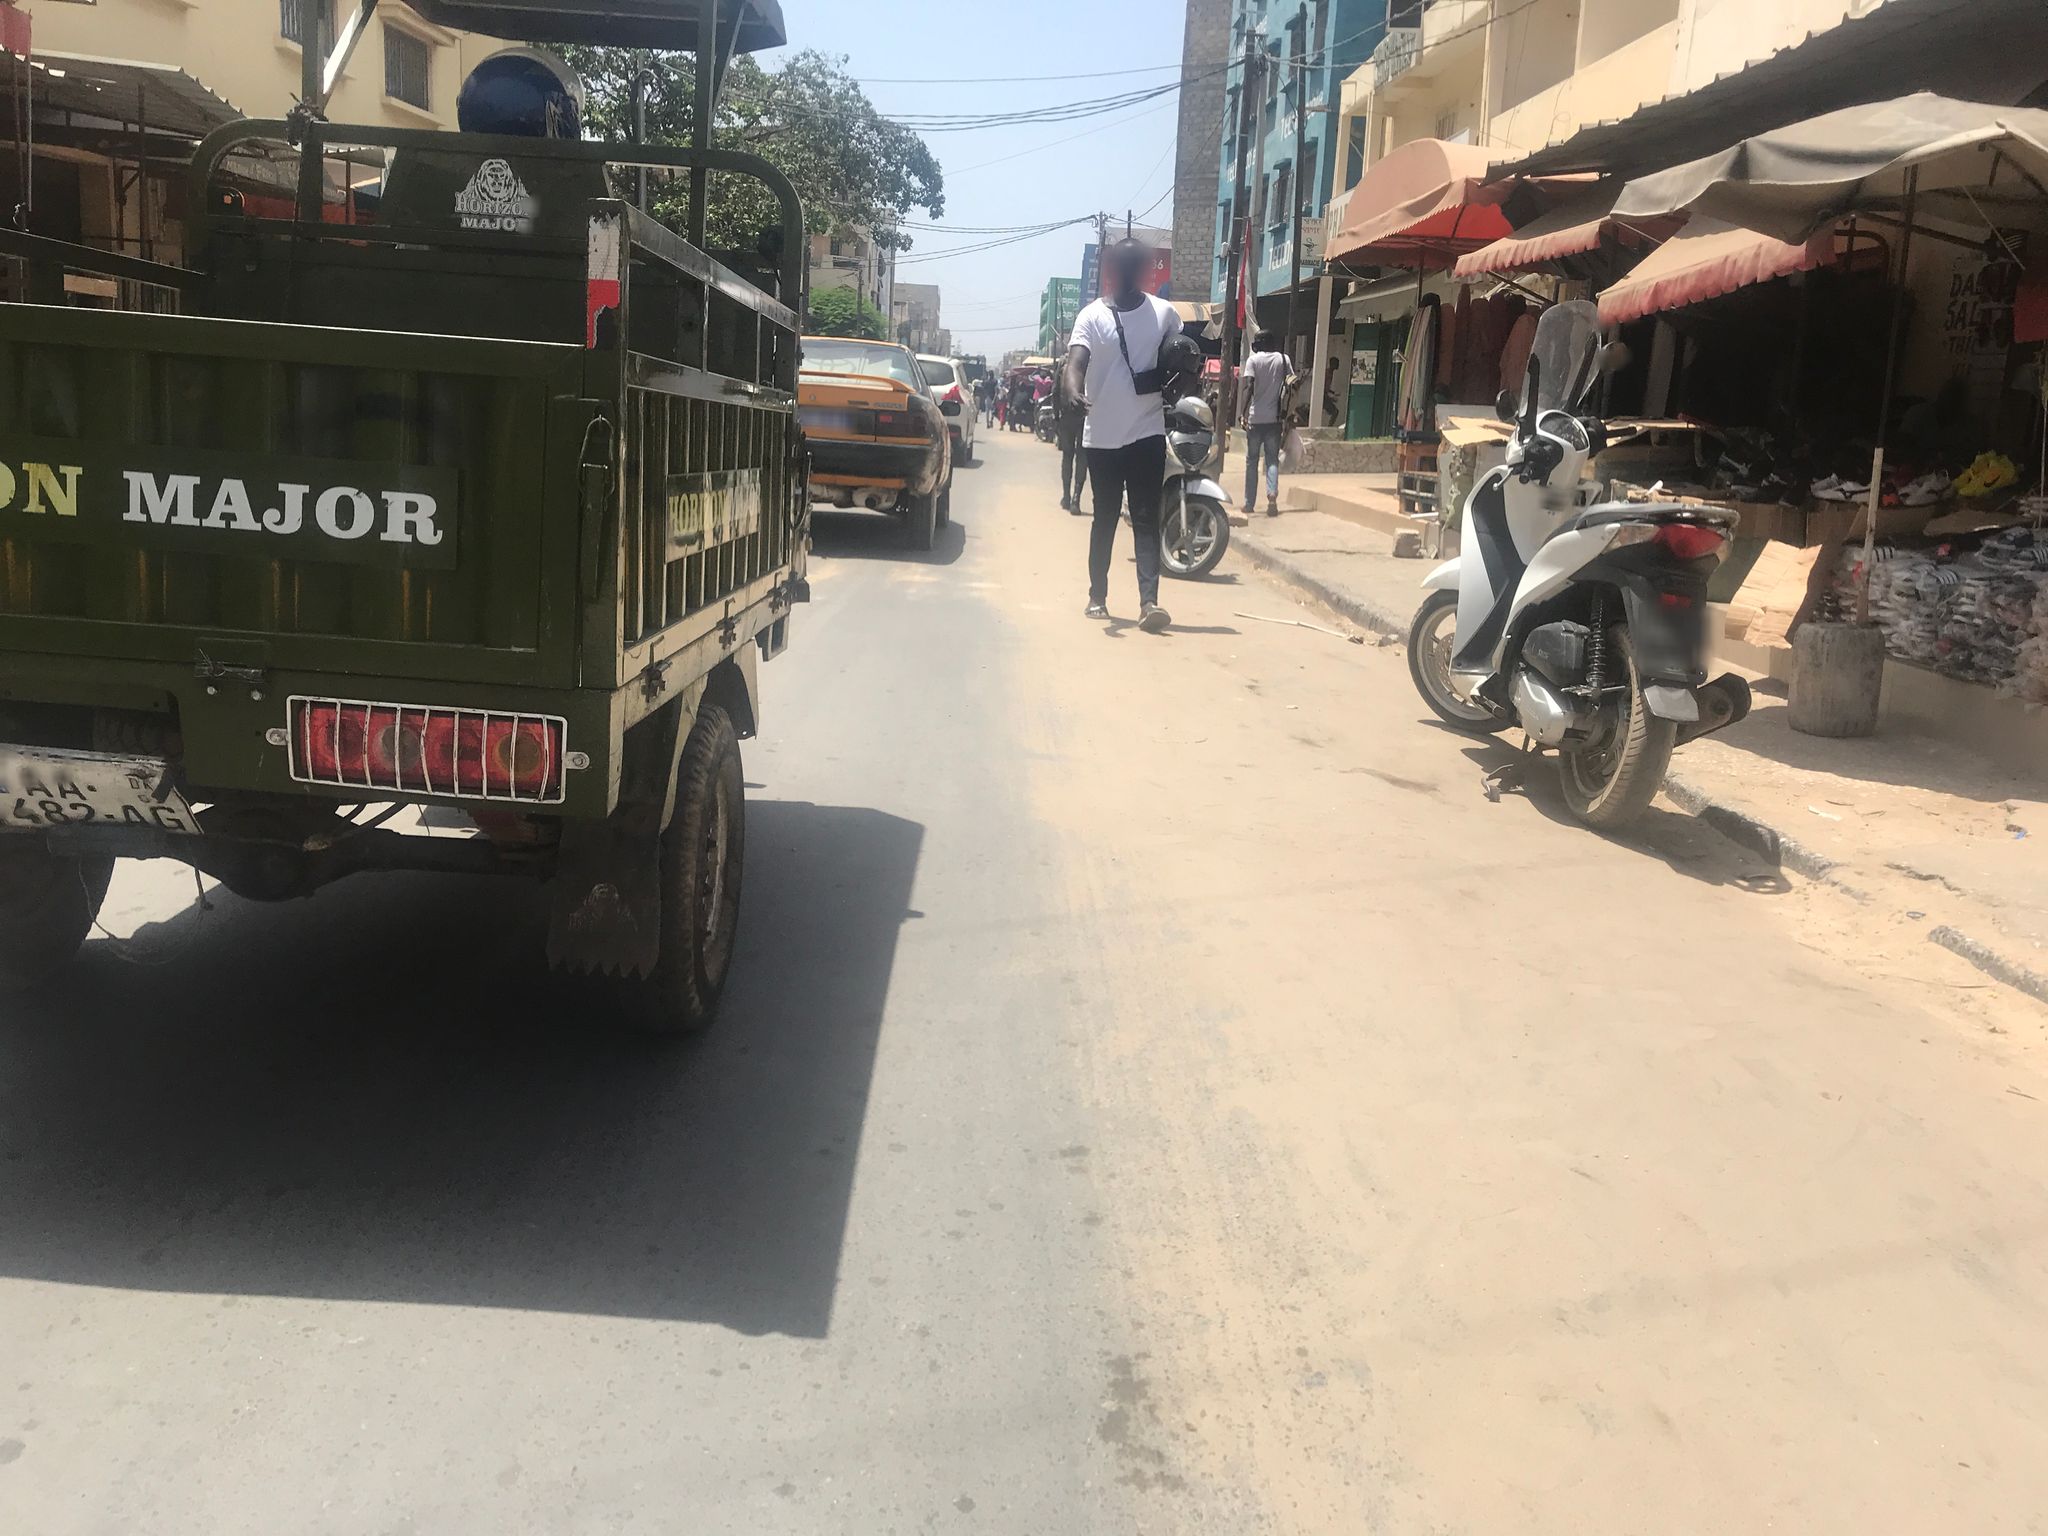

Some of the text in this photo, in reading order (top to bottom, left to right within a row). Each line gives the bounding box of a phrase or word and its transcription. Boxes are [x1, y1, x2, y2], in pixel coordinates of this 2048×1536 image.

[455, 191, 530, 216] HORIZO
[460, 217, 530, 233] MAJO
[0, 460, 443, 546] N MAJOR
